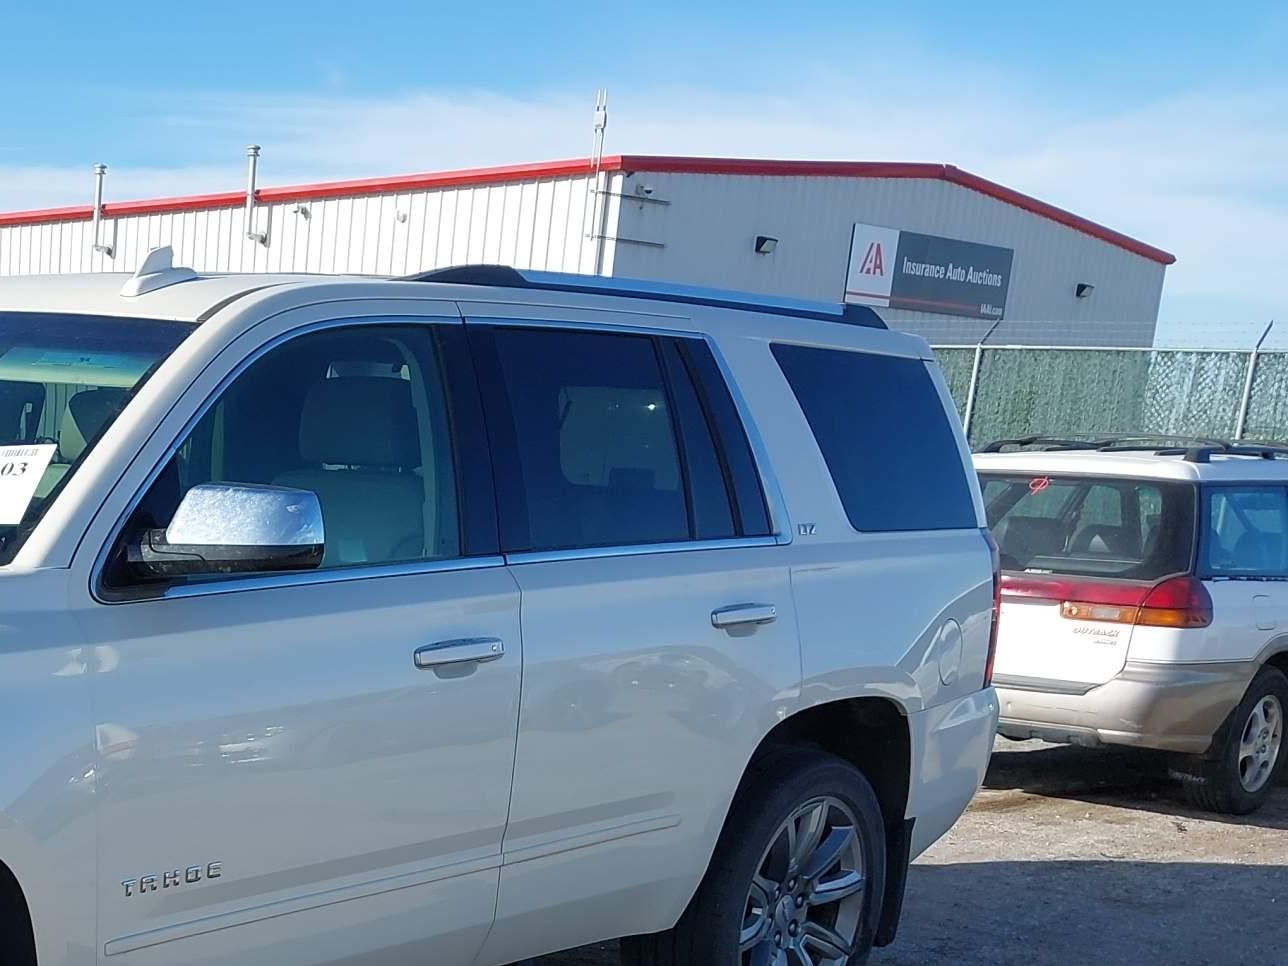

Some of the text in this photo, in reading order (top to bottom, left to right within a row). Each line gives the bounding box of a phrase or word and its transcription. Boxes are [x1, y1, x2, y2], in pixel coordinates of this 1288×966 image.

[902, 256, 1003, 287] Insurance Auto Auctions
[121, 861, 223, 897] TAHOE
